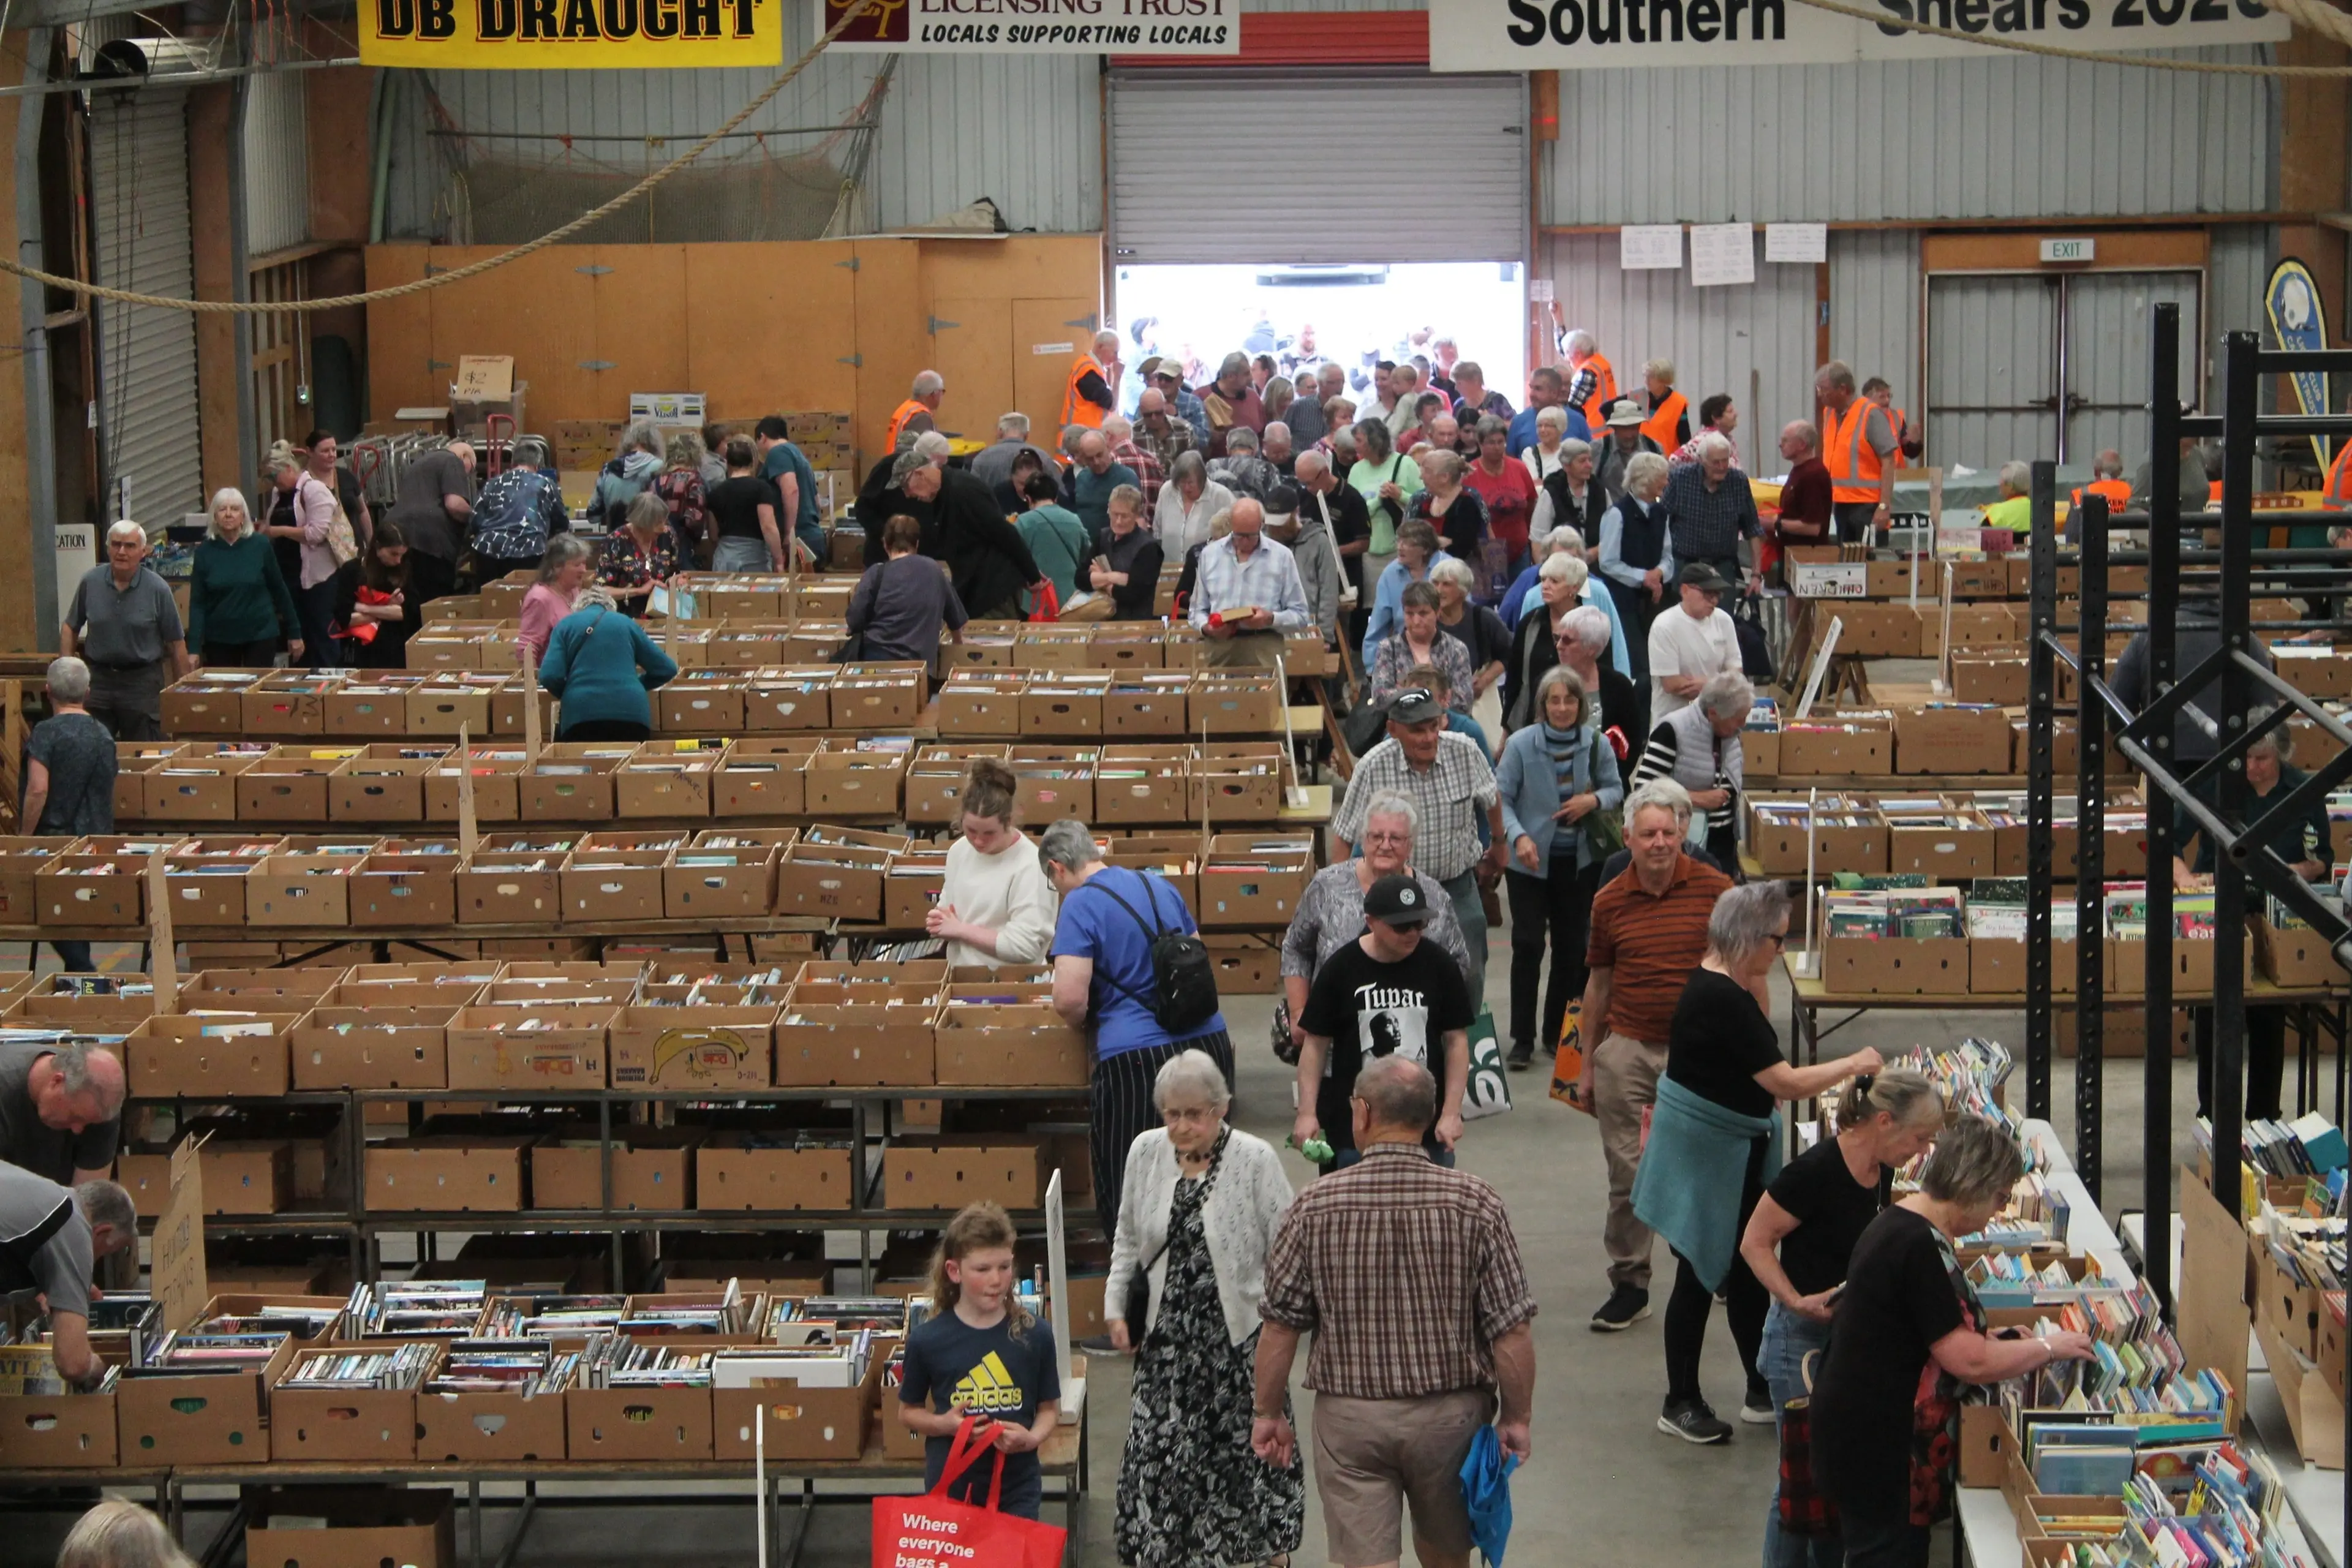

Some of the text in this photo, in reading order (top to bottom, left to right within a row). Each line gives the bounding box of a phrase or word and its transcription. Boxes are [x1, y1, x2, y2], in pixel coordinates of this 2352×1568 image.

[476, 0, 763, 41] DRAUGHT
[1507, 0, 1785, 45] Southern
[921, 24, 1227, 43] LOCALS SUPPORTING LOCALS
[2052, 242, 2081, 257] EXIT
[533, 1059, 573, 1075] Dole
[703, 1054, 728, 1065] Dole
[949, 1385, 1022, 1413] adidas
[902, 1512, 958, 1534] Where
[899, 1536, 974, 1558] everyone
